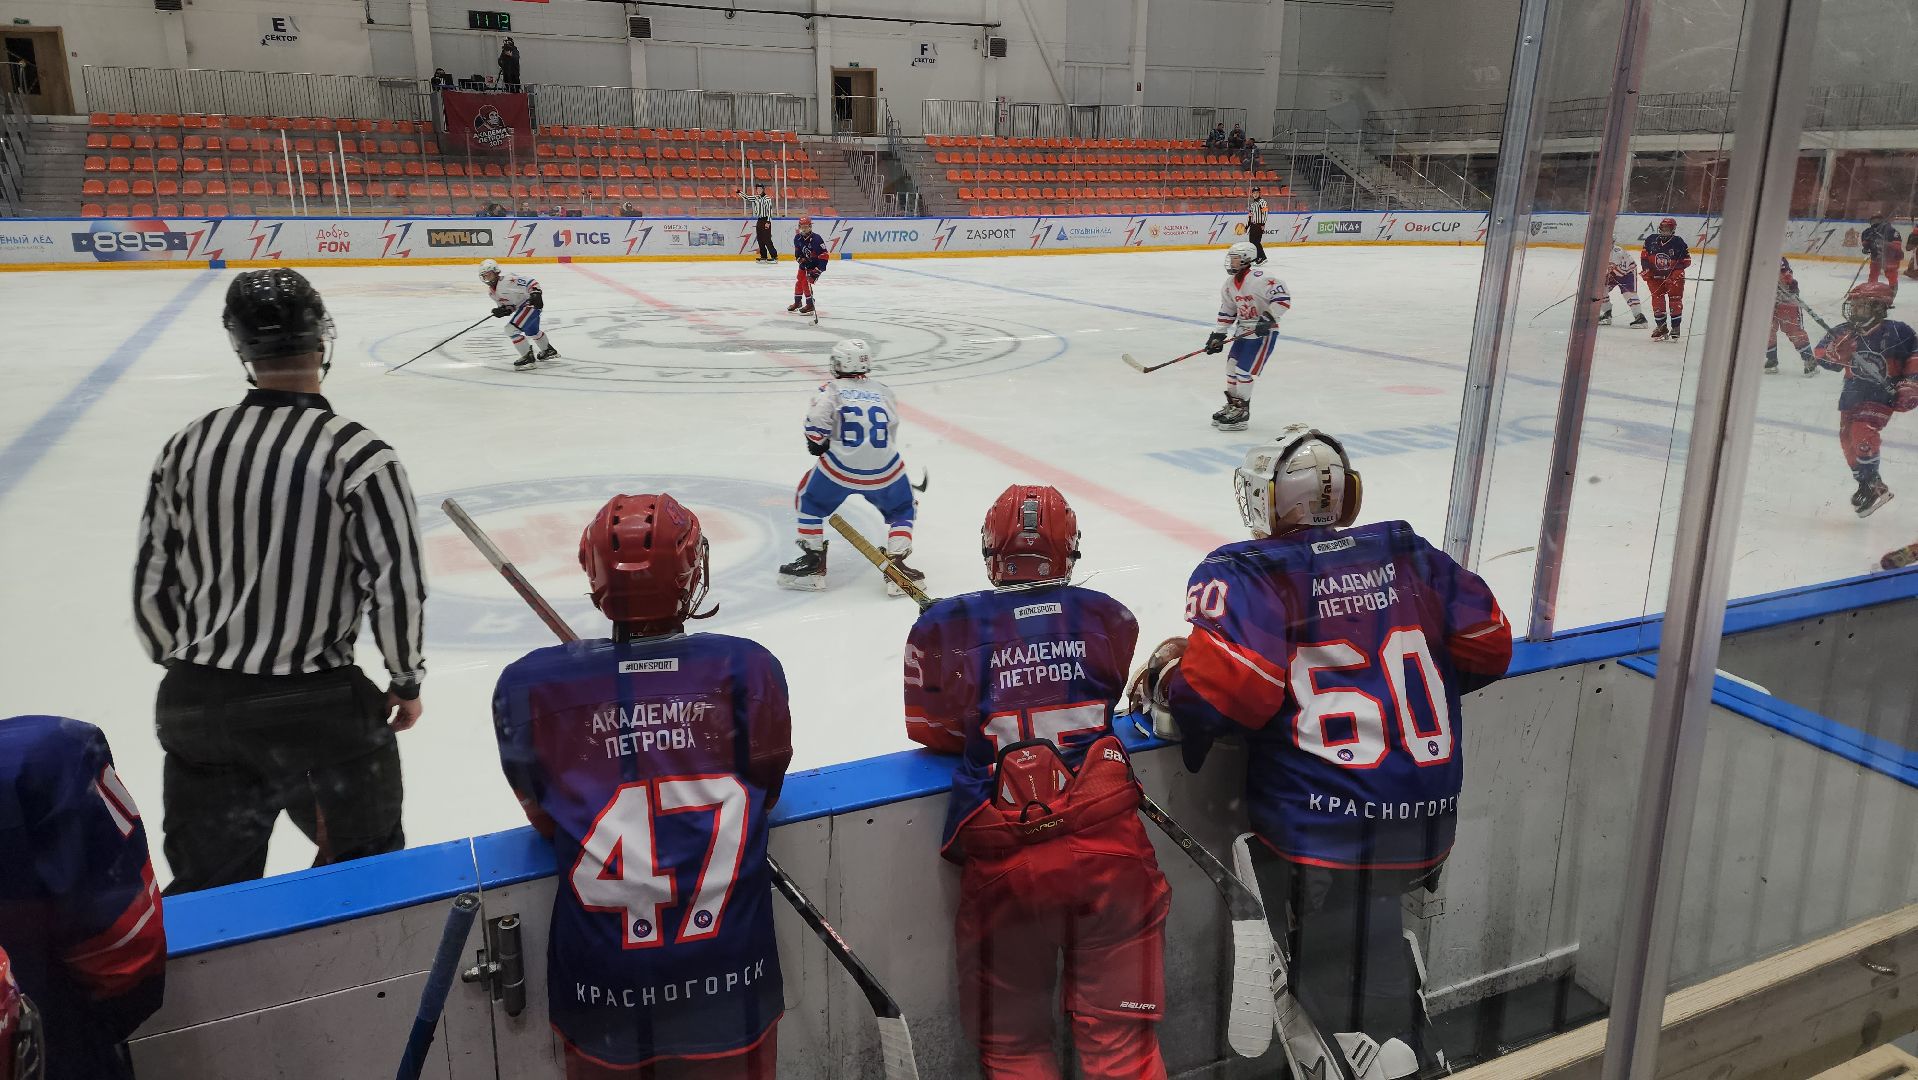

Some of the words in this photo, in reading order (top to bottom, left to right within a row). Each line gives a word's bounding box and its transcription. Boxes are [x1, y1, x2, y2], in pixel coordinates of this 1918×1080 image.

[271, 17, 287, 32] E
[264, 34, 298, 42] СЕКТОР
[920, 43, 929, 56] F
[32, 234, 54, 245] ЛЁД
[93, 231, 168, 252] 895
[316, 223, 350, 240] Добро
[575, 231, 611, 245] ПСБ
[862, 229, 919, 243] INVITRO
[966, 228, 1017, 240] ZASPORT
[318, 241, 351, 252] FON
[840, 405, 889, 448] 68
[1312, 562, 1397, 597] АКАДЕМИЯ
[1317, 588, 1400, 619] ПЕТРОВА
[990, 640, 1087, 669] АКАДЕМИЯ
[999, 661, 1086, 689] ПЕТРОВА
[1288, 624, 1454, 769] 60
[592, 701, 706, 734] АКАДЕМИЯ
[604, 726, 696, 759] ПЕТРОВА
[1309, 793, 1460, 820] КРАСНОГОРС
[1024, 818, 1064, 835] VAPOR
[569, 773, 748, 950] 47
[576, 957, 764, 1008] КРАСНОГОРСК
